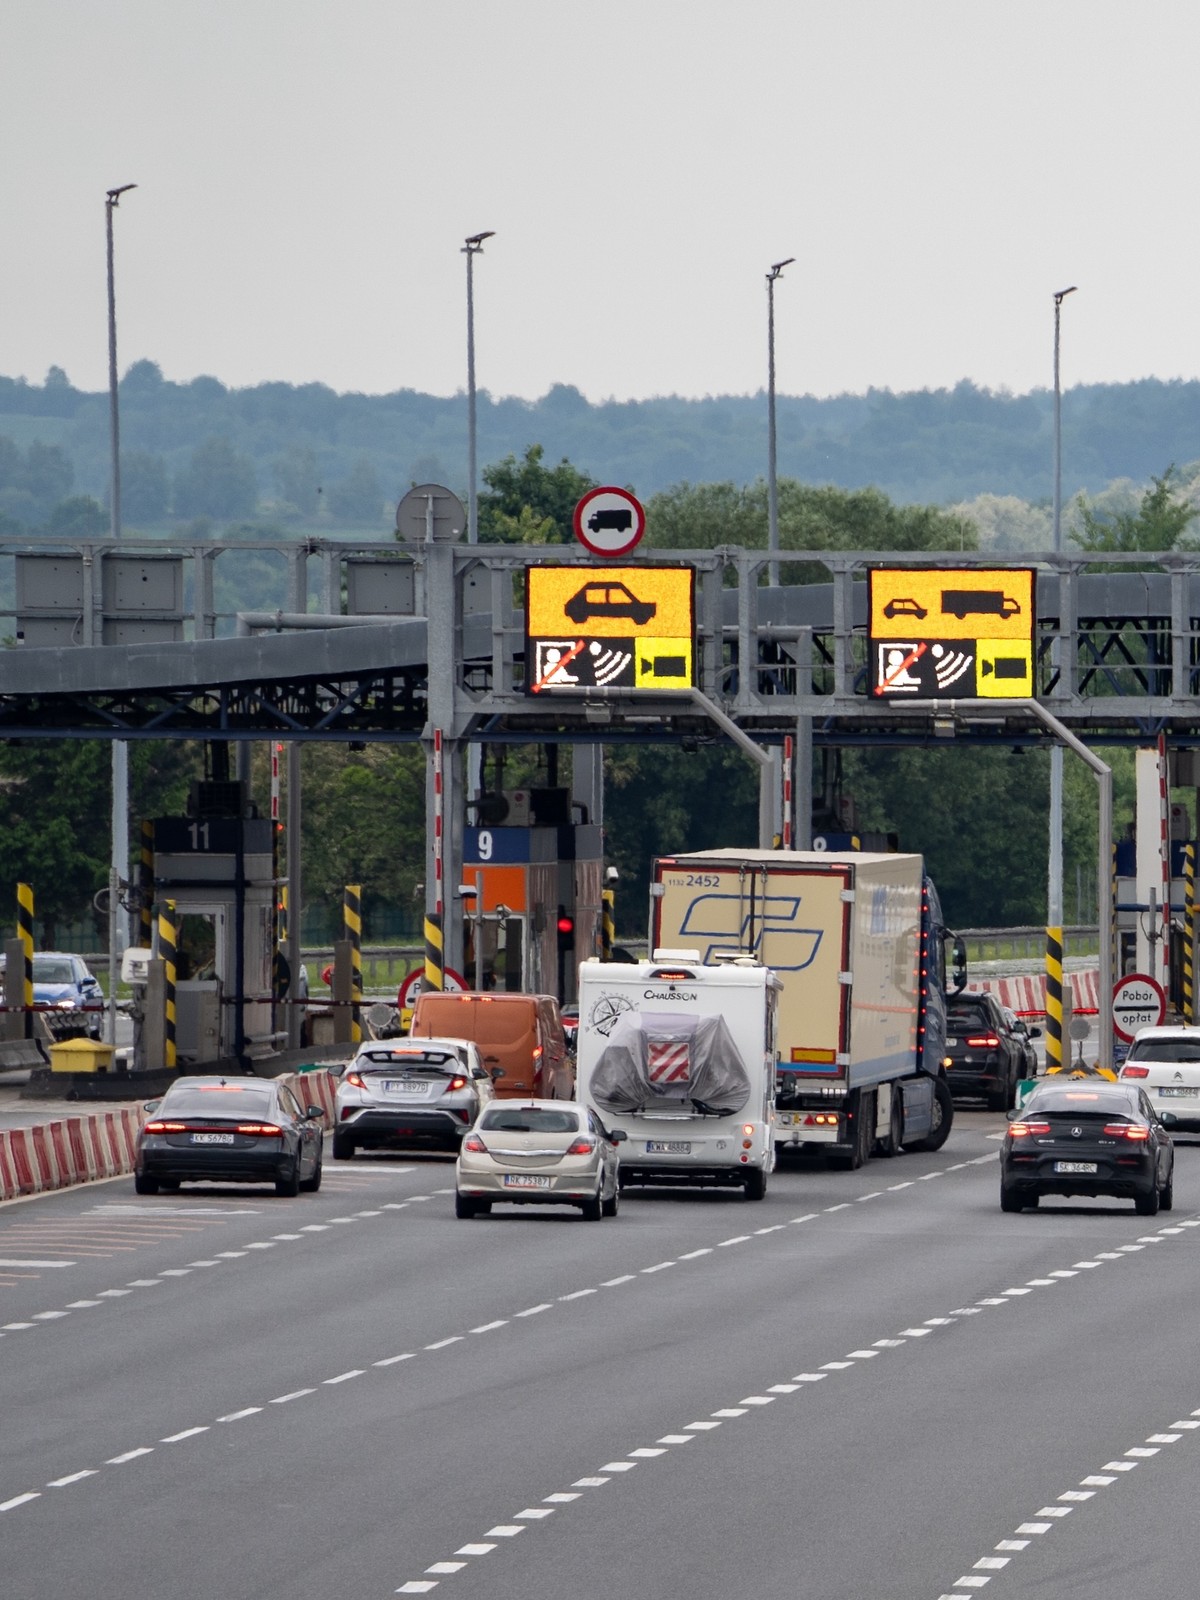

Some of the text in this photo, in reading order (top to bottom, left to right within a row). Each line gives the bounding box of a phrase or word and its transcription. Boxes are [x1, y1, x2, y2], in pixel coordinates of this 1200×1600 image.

[188, 822, 209, 849] 11
[478, 831, 492, 860] 9
[686, 875, 719, 888] 2452
[1122, 990, 1153, 1001] Pobór
[1122, 1013, 1152, 1026] opłat
